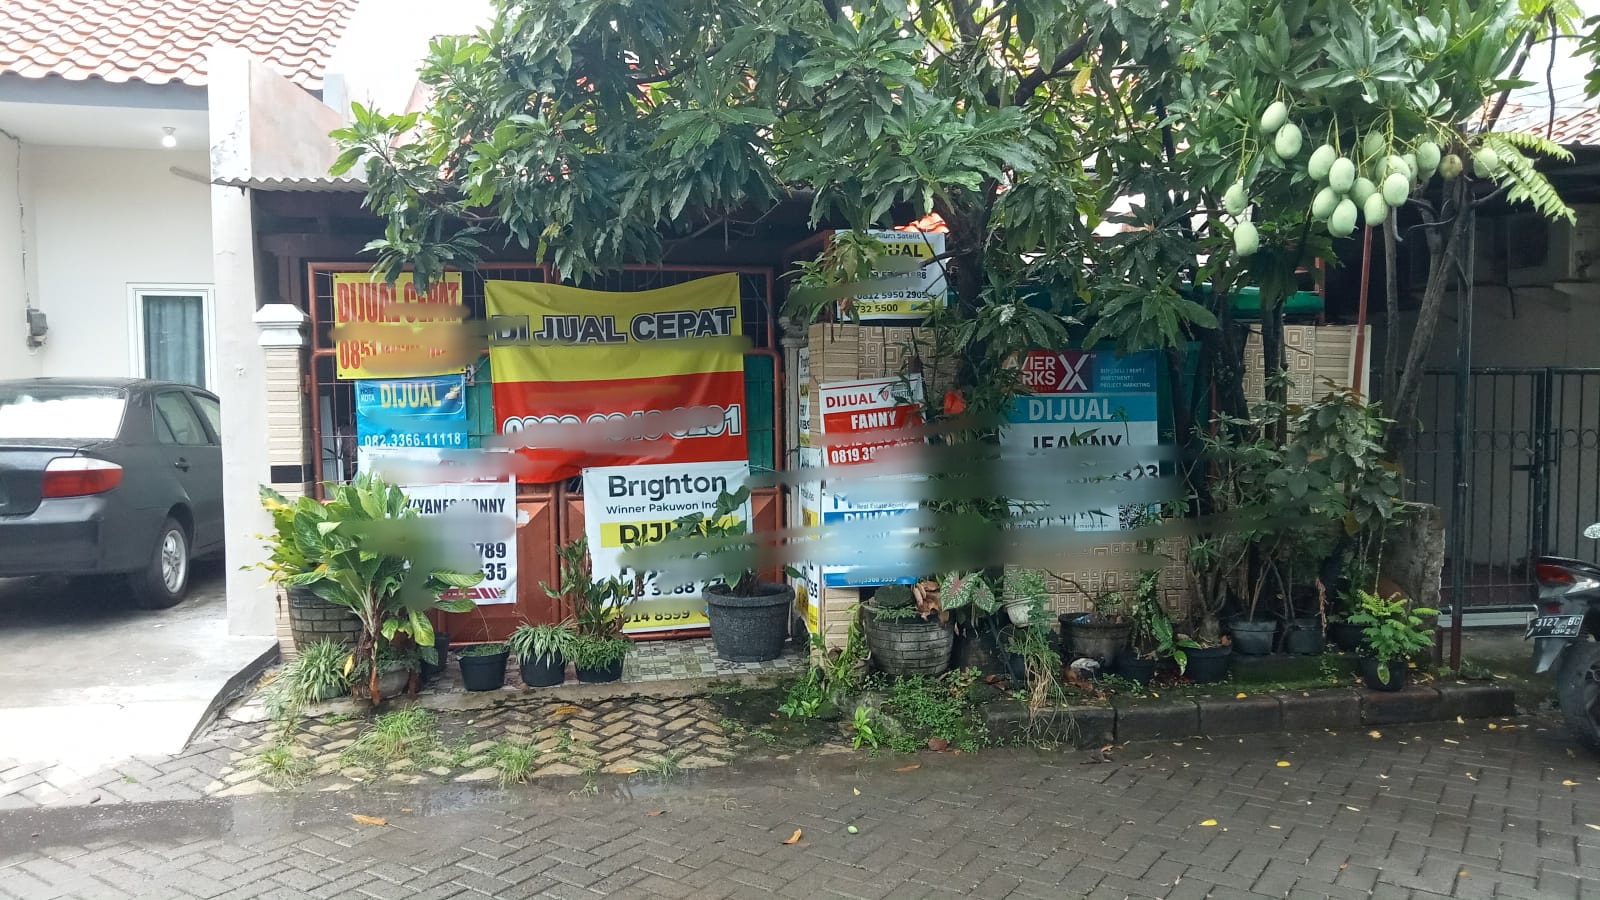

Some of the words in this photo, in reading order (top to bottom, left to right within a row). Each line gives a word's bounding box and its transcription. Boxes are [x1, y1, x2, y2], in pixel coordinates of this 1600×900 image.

[404, 281, 460, 323] CPAT
[881, 291, 904, 299] 5950
[874, 303, 898, 312] 5500
[534, 316, 628, 345] JUAL
[631, 306, 737, 344] CEPAT
[380, 383, 442, 409] DIJUAL
[825, 392, 877, 408] DIJUAL
[1028, 398, 1114, 421] DIJUAL
[851, 410, 897, 430] FANNY
[364, 431, 462, 448] 082.3366.11118
[831, 447, 860, 464] 0819
[607, 473, 727, 501] Brighton
[606, 505, 646, 514] Winner
[648, 501, 699, 513] Pakuwon
[1535, 617, 1560, 627] 3127
